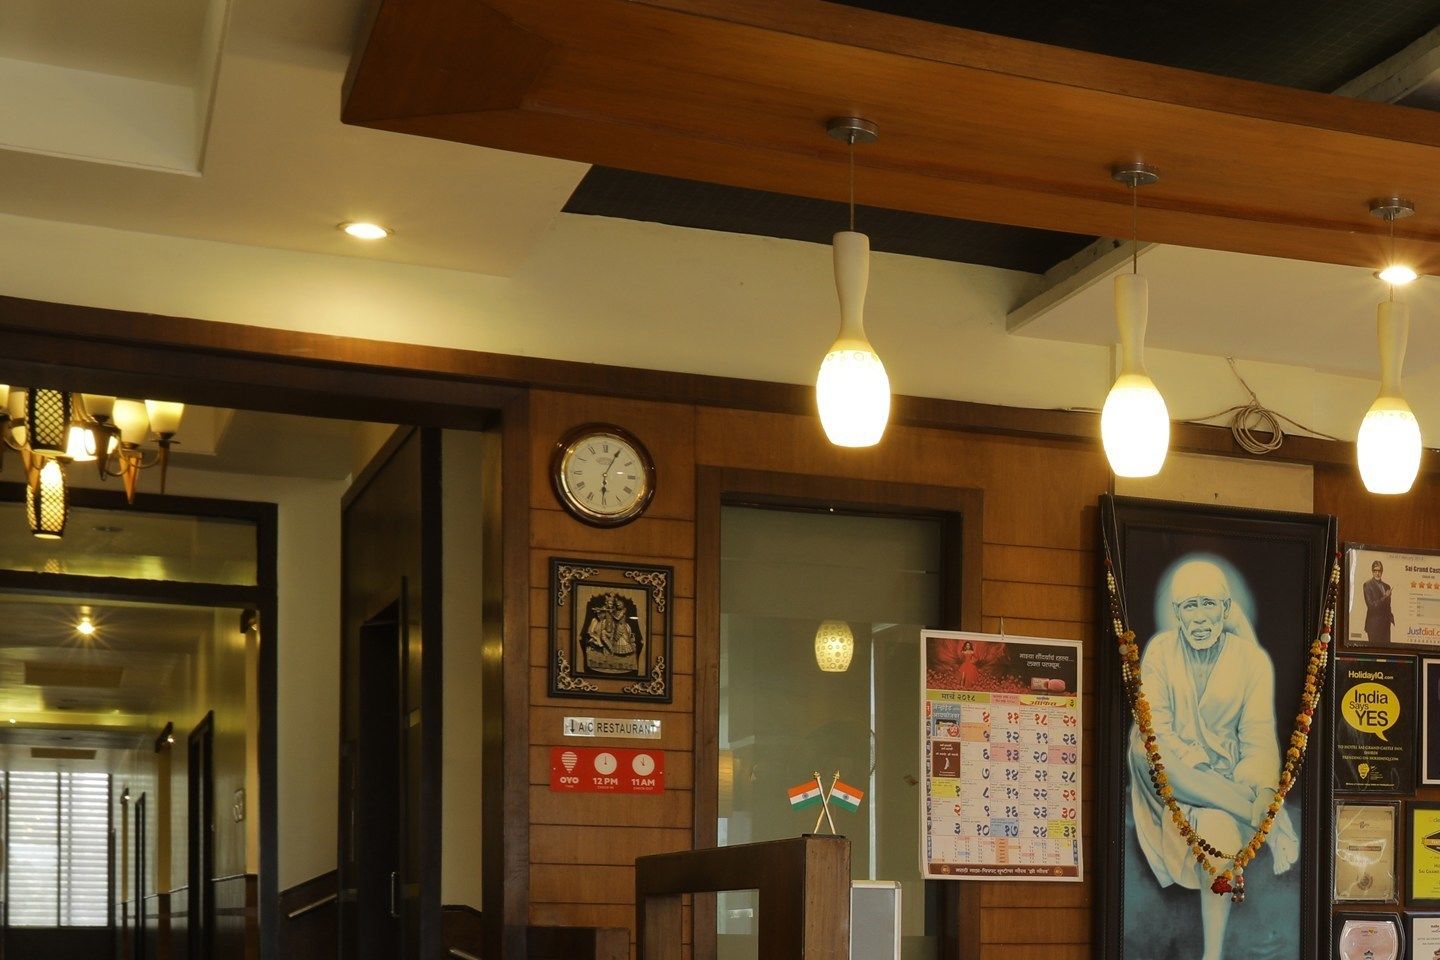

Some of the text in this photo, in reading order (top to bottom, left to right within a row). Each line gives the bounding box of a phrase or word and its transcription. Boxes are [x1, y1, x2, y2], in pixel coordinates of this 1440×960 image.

[1355, 690, 1388, 704] India
[1349, 701, 1369, 711] Says
[983, 712, 1076, 727] ४ ११ १८ २५
[1355, 710, 1388, 726] YES
[579, 722, 656, 734] A/C RESTAURANT
[983, 731, 1076, 746] ५ १२ १९ २६
[983, 749, 1076, 764] ६ १३ २० २७
[560, 776, 579, 784] OYO
[982, 768, 1075, 783] ७ १४ २१ २८
[955, 786, 1076, 801] १ ८ १५ २२ २९
[954, 804, 1076, 819] २ ९ १६ २३ ३०
[954, 823, 1076, 838] ३ १० १७ २४ ३१
